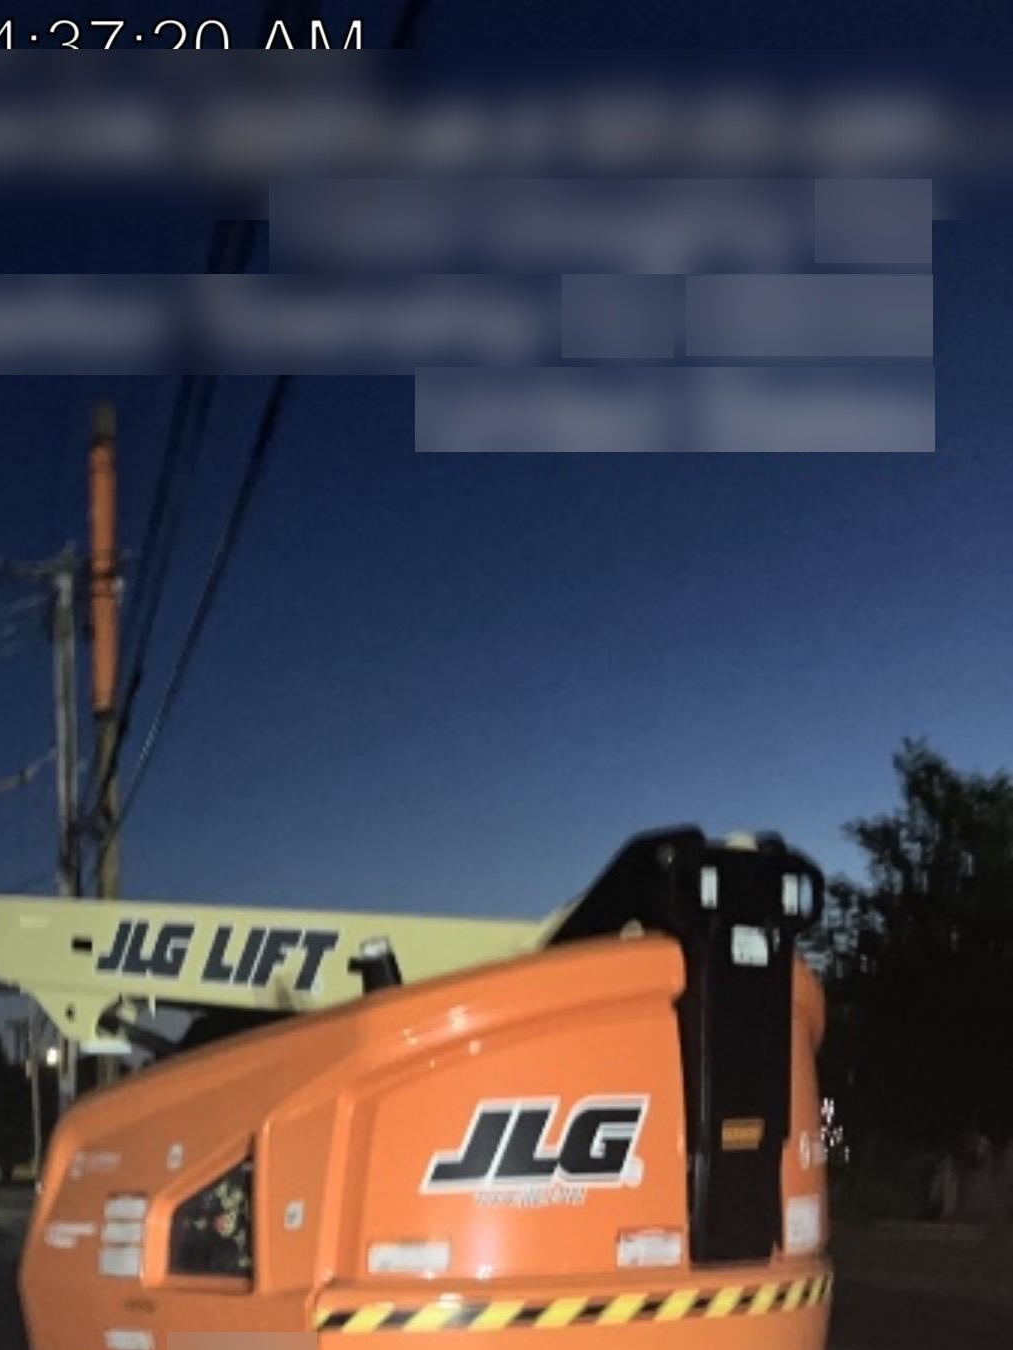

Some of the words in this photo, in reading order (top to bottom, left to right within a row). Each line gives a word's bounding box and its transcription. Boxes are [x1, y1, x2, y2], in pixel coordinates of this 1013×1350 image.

[96, 920, 195, 978] JLG
[200, 925, 340, 991] LIFT
[422, 1097, 648, 1190] JLG
